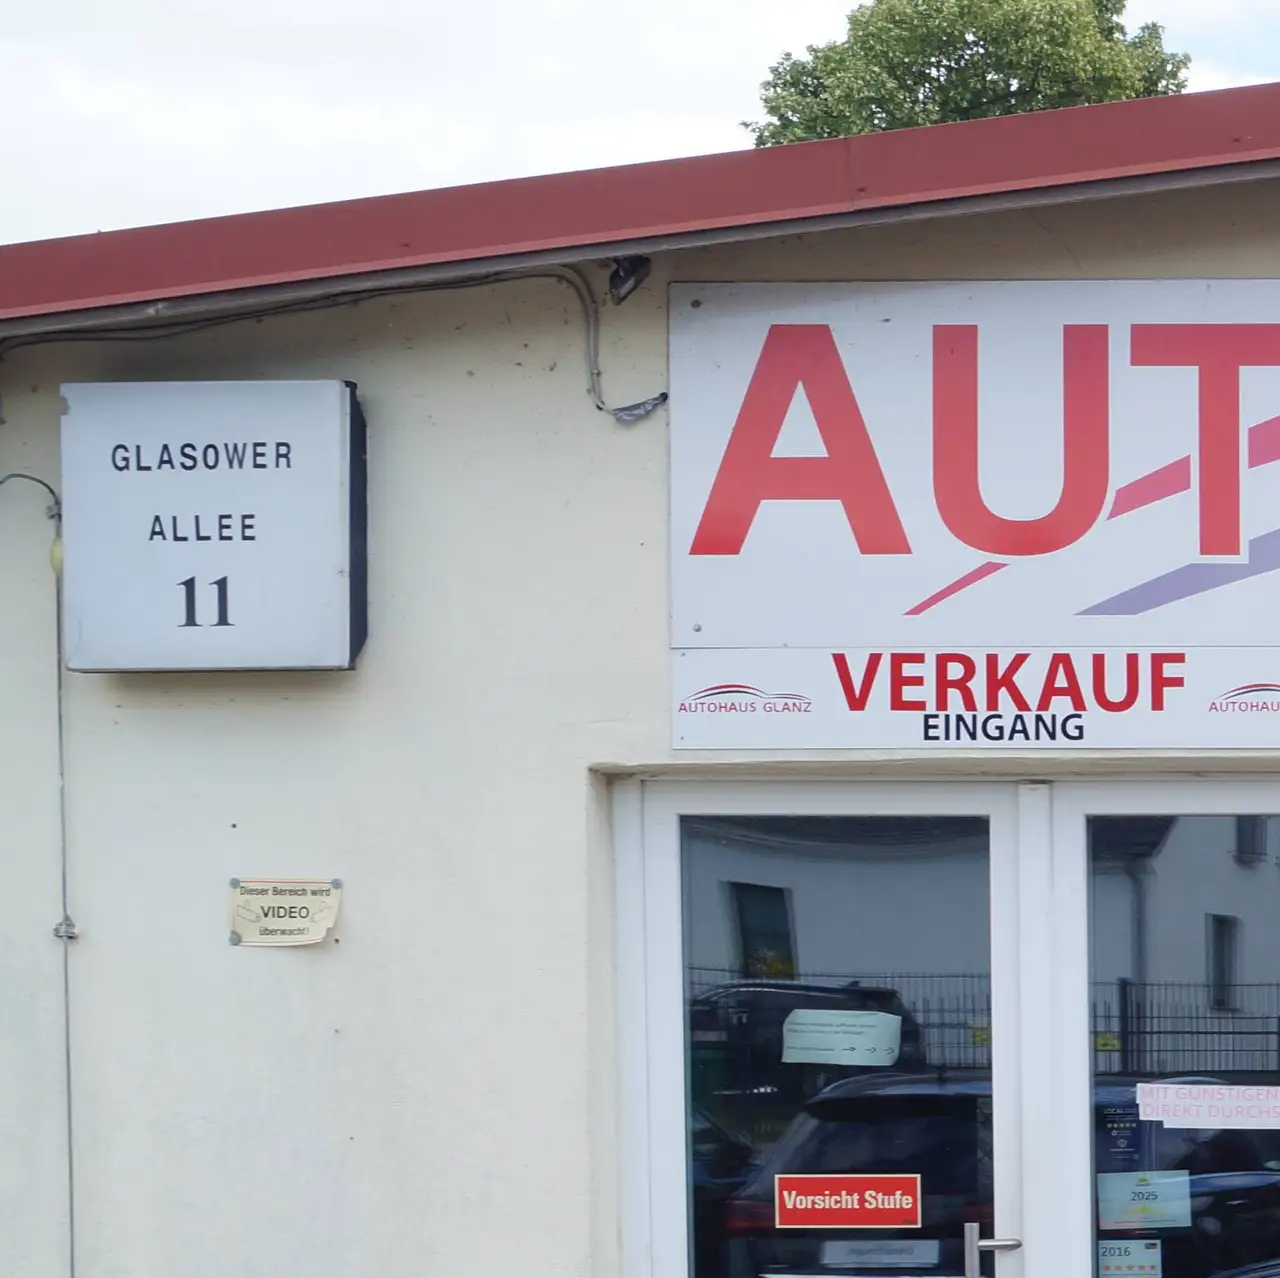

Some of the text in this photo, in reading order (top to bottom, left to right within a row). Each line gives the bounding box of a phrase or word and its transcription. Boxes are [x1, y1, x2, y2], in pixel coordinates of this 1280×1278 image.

[111, 441, 293, 472] GLASOWER
[148, 513, 257, 542] ALLEE
[175, 575, 236, 628] 11
[831, 652, 1187, 713] VERKAUF
[678, 702, 813, 713] AUTOHAUS GLANZ
[923, 713, 1085, 743] EINGANG
[240, 886, 331, 897] Dieser Bereich wird
[260, 905, 310, 919] VIDEO
[1140, 1086, 1169, 1100] MIT
[1143, 1103, 1203, 1117] DIREKT
[782, 1190, 913, 1209] Vorsicht Stufe
[1131, 1191, 1158, 1201] 2025
[1101, 1246, 1131, 1257] 2016
